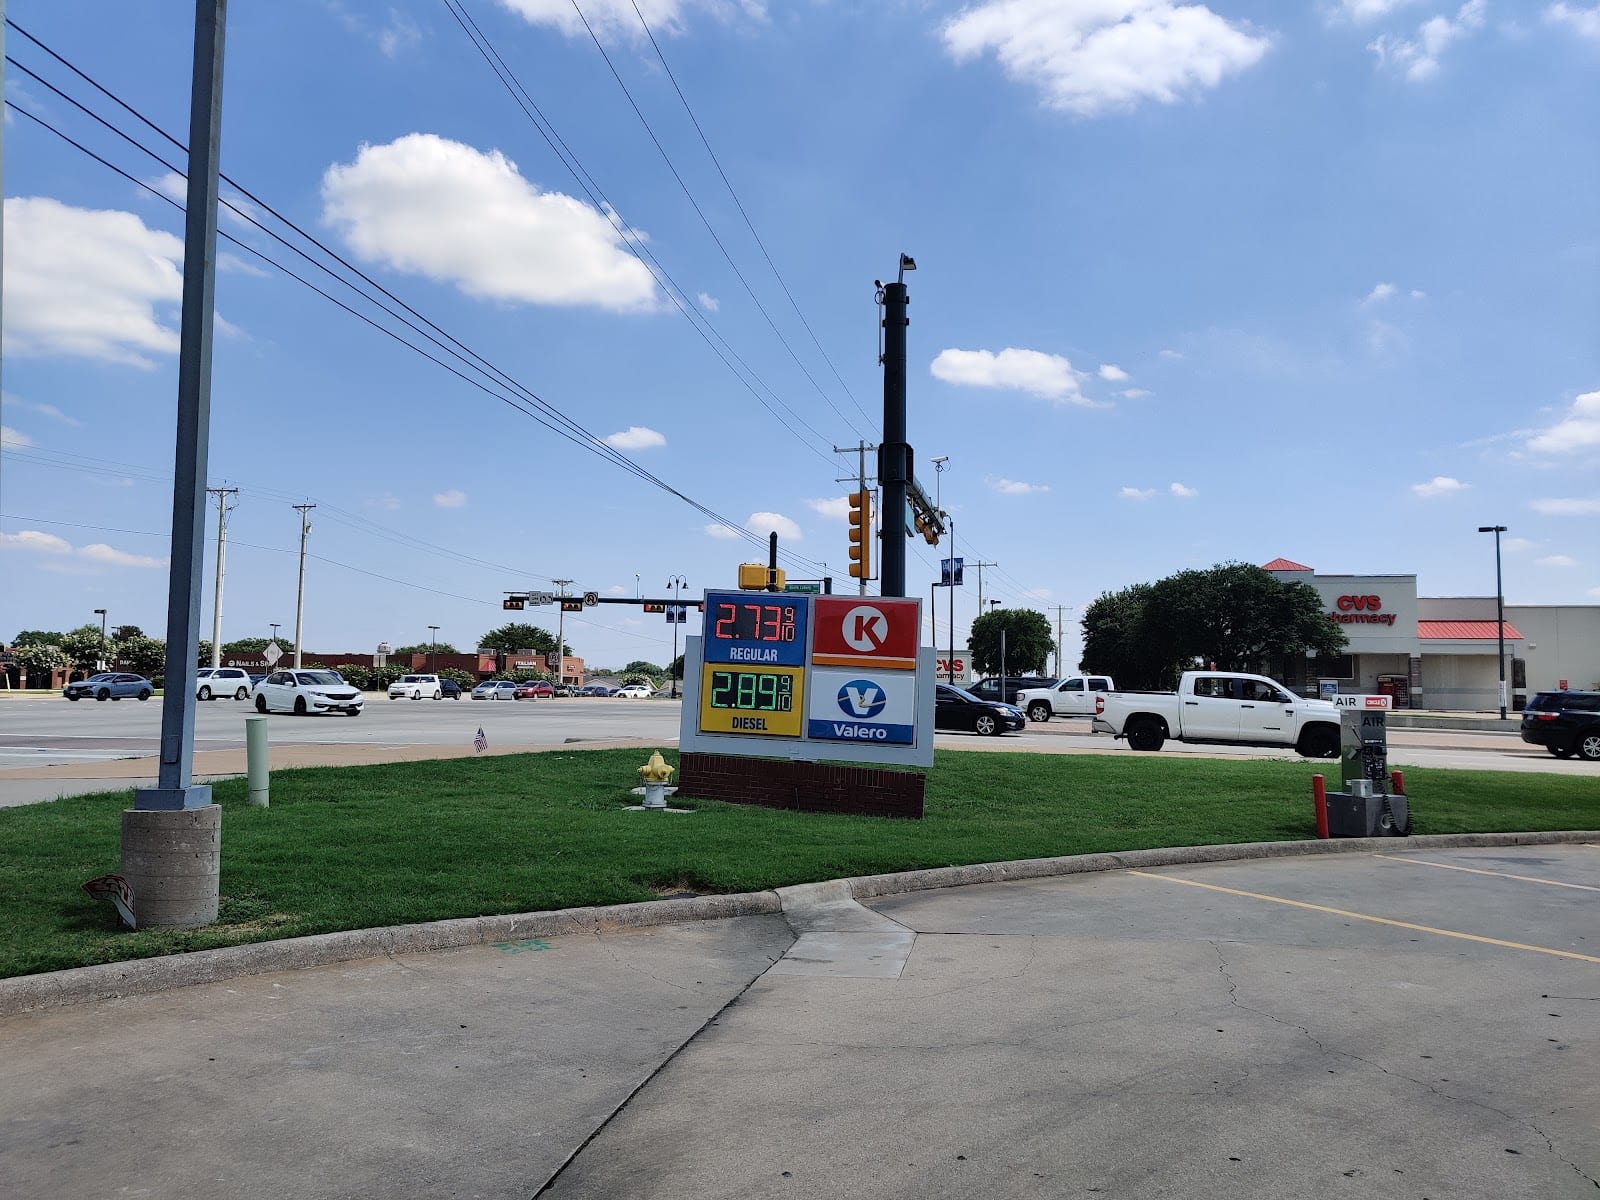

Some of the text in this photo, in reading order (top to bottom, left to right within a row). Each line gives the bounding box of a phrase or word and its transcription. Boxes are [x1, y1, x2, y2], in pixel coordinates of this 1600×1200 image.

[1337, 594, 1382, 611] CVS
[715, 603, 782, 641] 2.73
[1328, 611, 1398, 626] harmacy
[730, 647, 778, 662] REGULAR
[711, 672, 778, 710] 2.89
[1335, 697, 1357, 706] AIR
[731, 716, 769, 731] DIESEL
[1362, 716, 1385, 727] AIR
[833, 723, 888, 740] Valero
